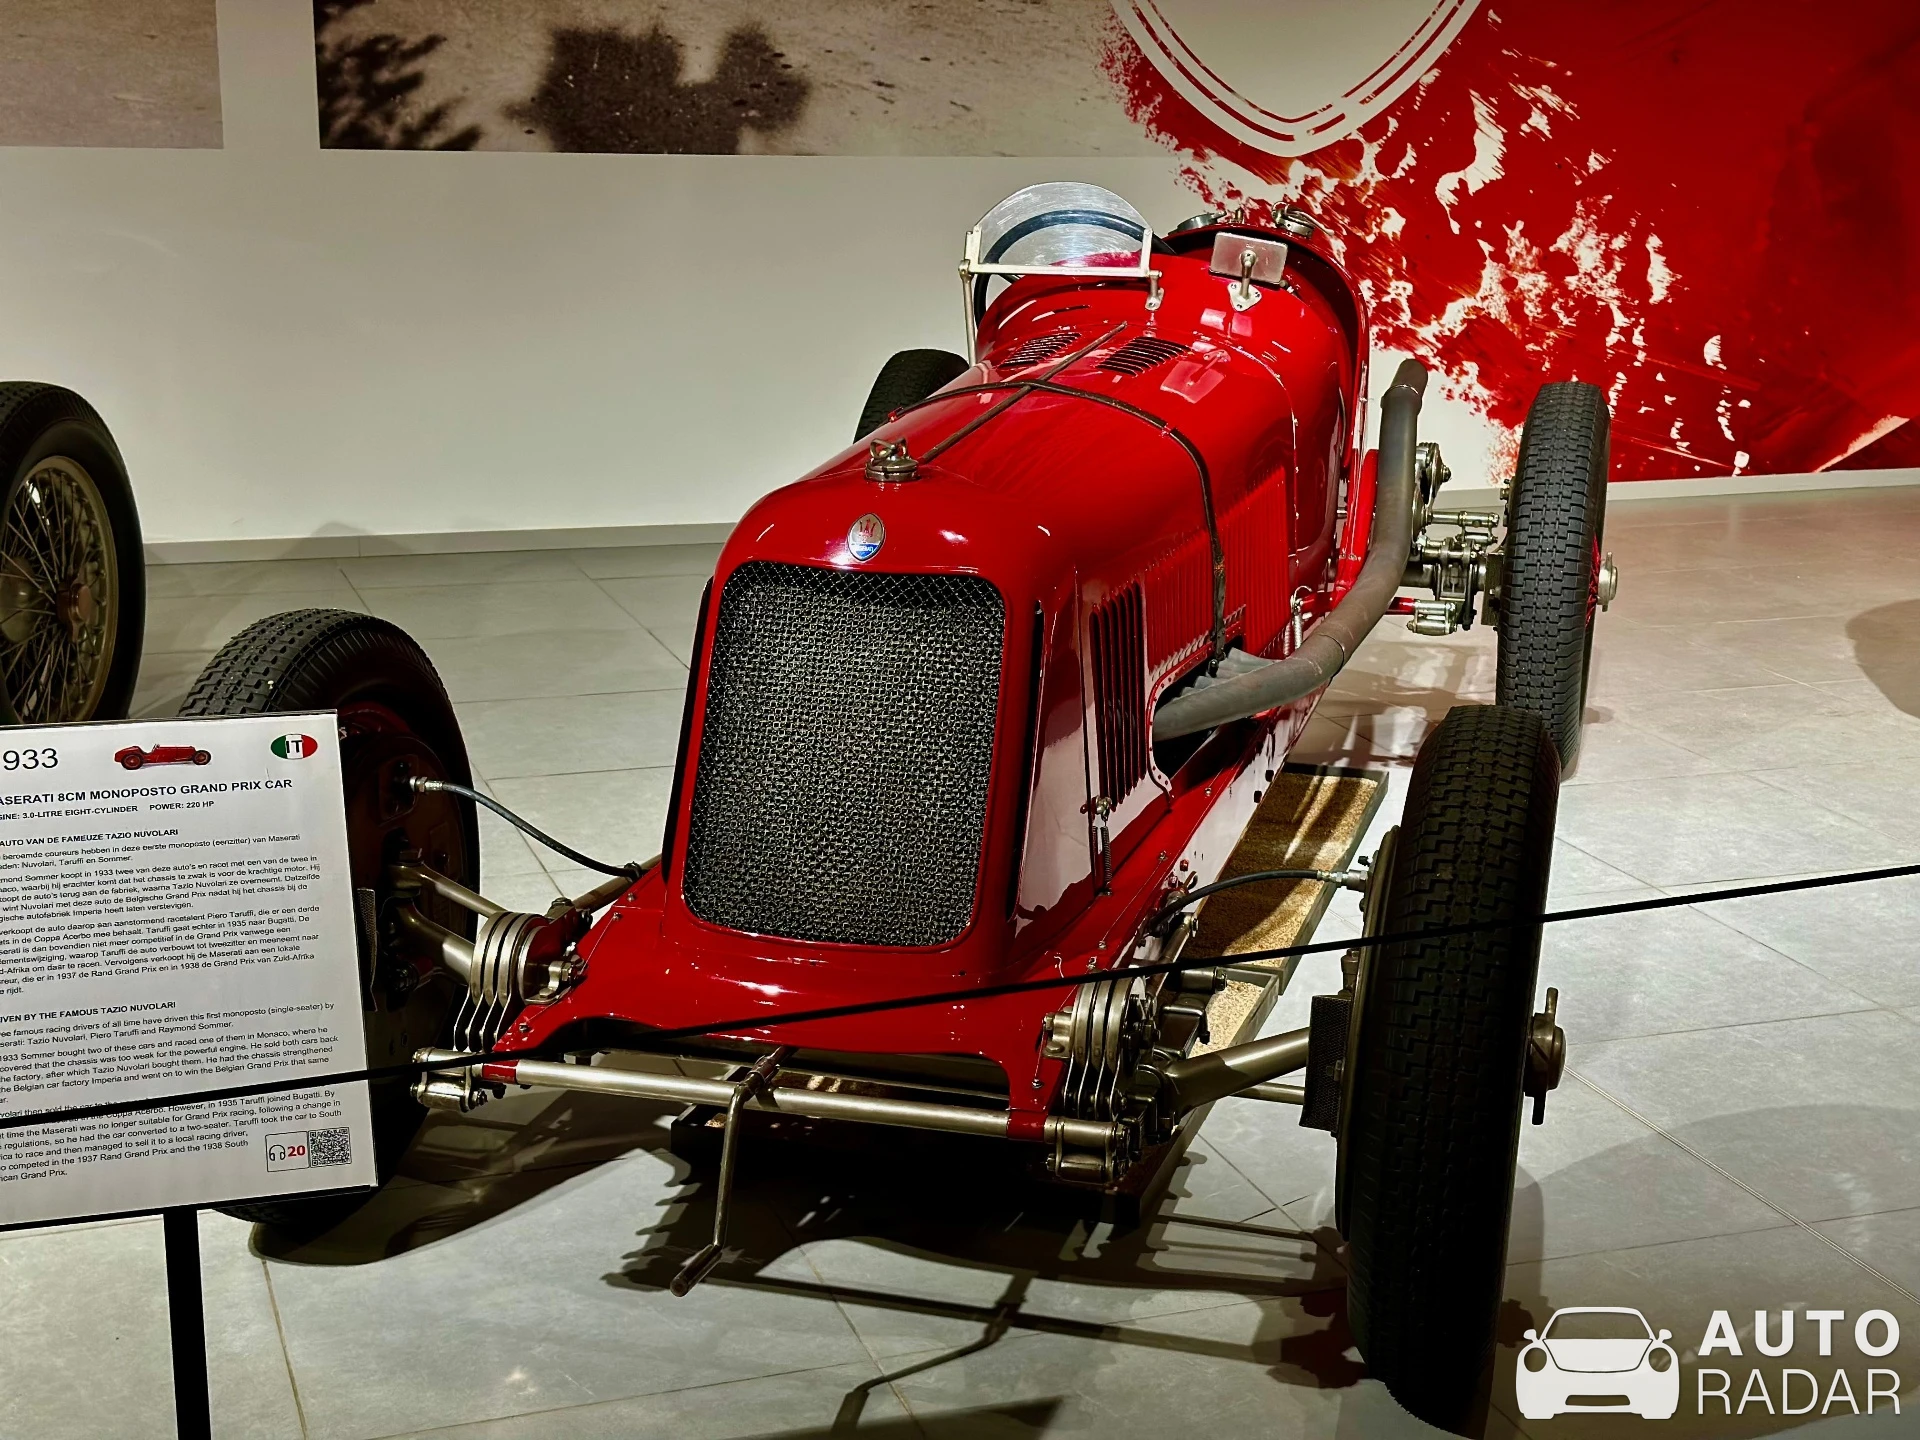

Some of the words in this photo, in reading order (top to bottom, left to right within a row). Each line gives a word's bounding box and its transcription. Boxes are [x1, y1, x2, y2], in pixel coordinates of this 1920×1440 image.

[286, 740, 303, 753] IT
[3, 748, 59, 771] 933
[57, 791, 86, 802] 8CM
[89, 786, 176, 799] MONOPOSTO
[180, 783, 227, 794] GRAND
[231, 780, 261, 791] PRIX
[264, 779, 292, 789] CAR
[22, 810, 62, 819] 3.0-LITRE
[64, 805, 138, 816] EIGHT-CYLINDER
[149, 802, 184, 811] POWER:
[185, 801, 201, 809] 220
[201, 800, 215, 808] HP
[25, 837, 45, 845] VAN
[46, 836, 59, 844] DE
[61, 833, 103, 843] FAMEUZE
[104, 831, 132, 840] TAZIO
[133, 828, 178, 838] NUVOLARI
[13, 1028, 44, 1036] famous
[46, 1025, 71, 1034] racing
[73, 1023, 100, 1031] drivers
[123, 1019, 141, 1027] time
[142, 1017, 163, 1025] have
[164, 1015, 189, 1023] driven
[190, 1013, 205, 1021] this
[206, 1011, 221, 1019] first
[268, 1002, 324, 1015] (single-seater)
[23, 1013, 37, 1021] BY
[38, 1011, 57, 1020] THE
[59, 1008, 99, 1018] FAMOUS
[100, 1005, 128, 1014] TAZIO
[129, 1001, 176, 1012] NUVOLARI
[21, 1051, 55, 1060] Sommer
[57, 1048, 86, 1057] bought
[114, 1044, 137, 1052] these
[138, 1042, 156, 1050] cars
[156, 1039, 173, 1048] and
[225, 1034, 246, 1042] them
[292, 1028, 317, 1036] where
[27, 1036, 50, 1045] Tazio
[113, 1028, 140, 1037] Taruffi
[140, 1026, 157, 1035] and
[158, 1023, 197, 1034] Raymond
[45, 1070, 65, 1079] after
[66, 1067, 90, 1077] which
[92, 1065, 115, 1074] Tazio
[116, 1062, 150, 1072] Nuvolari
[251, 1050, 281, 1060] chassis
[283, 1045, 333, 1057] strengthened
[67, 1057, 98, 1066] chassis
[133, 1051, 154, 1060] weak
[183, 1045, 218, 1056] powerful
[264, 1039, 281, 1049] sold
[282, 1038, 300, 1047] both
[13, 1083, 45, 1092] Belgian
[61, 1079, 90, 1087] factory
[92, 1075, 122, 1085] Imperia
[123, 1073, 140, 1082] and
[215, 1064, 245, 1073] Belgian
[247, 1060, 272, 1070] Grand
[291, 1058, 306, 1066] that
[217, 1097, 238, 1107] 1935
[238, 1095, 265, 1106] Taruffi
[266, 1093, 291, 1105] joined
[6, 1130, 25, 1138] time
[42, 1124, 78, 1135] Maserati
[111, 1120, 137, 1129] longer
[185, 1111, 210, 1121] Grand
[259, 1104, 294, 1114] following
[302, 1101, 332, 1110] change
[127, 1126, 168, 1137] converted
[261, 1115, 278, 1124] took
[319, 1109, 342, 1118] South
[9, 1159, 50, 1170] competed
[77, 1153, 98, 1163] 1937
[124, 1149, 150, 1159] Grand
[203, 1141, 223, 1151] 1938
[224, 1139, 249, 1149] South
[25, 1150, 44, 1158] race
[63, 1146, 83, 1154] then
[85, 1141, 123, 1152] managed
[196, 1132, 222, 1141] racing
[288, 1145, 306, 1157] 20
[21, 1170, 47, 1180] Grand
